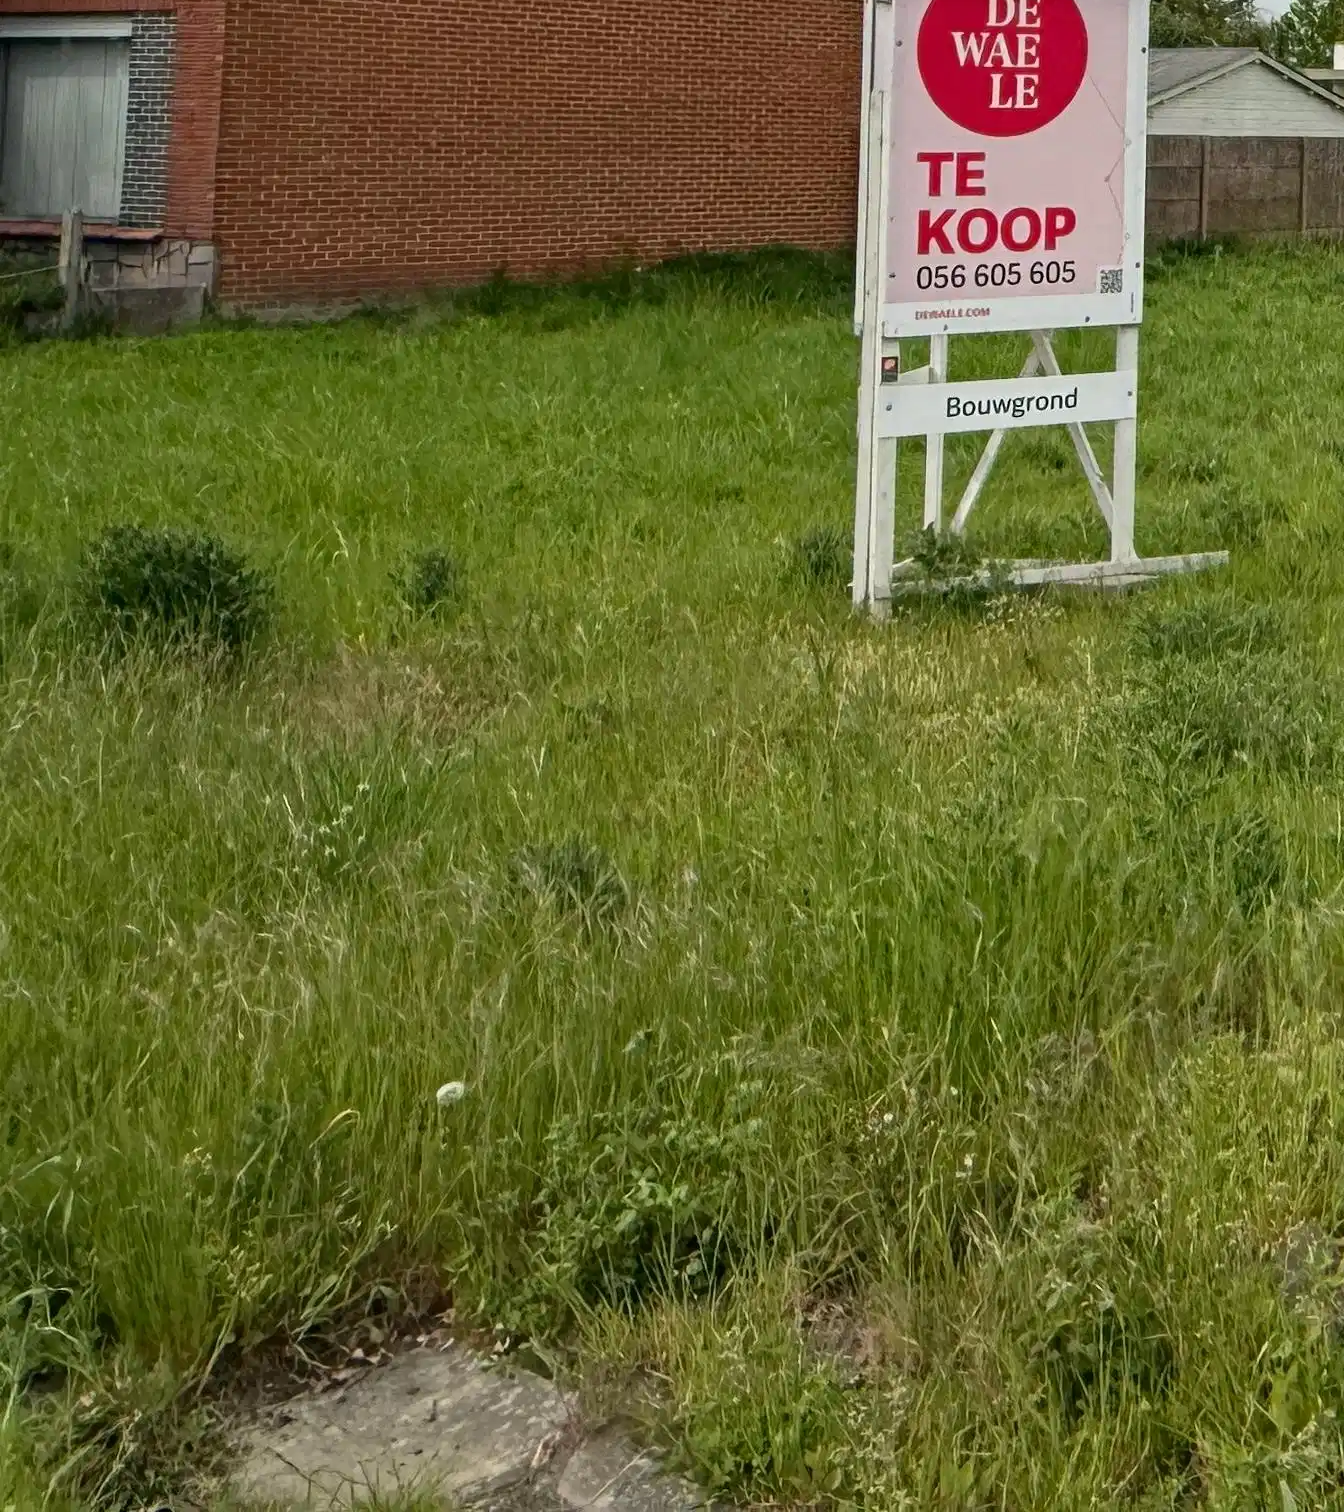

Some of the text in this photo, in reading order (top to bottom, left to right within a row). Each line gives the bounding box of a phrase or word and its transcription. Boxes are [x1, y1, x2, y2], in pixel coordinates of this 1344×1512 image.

[951, 31, 1040, 69] WAE
[989, 72, 1038, 109] LE
[916, 152, 986, 196] TE
[916, 207, 1076, 255] KOOP
[916, 260, 1076, 290] 056 605 605
[946, 387, 1078, 418] Bouwgrond
